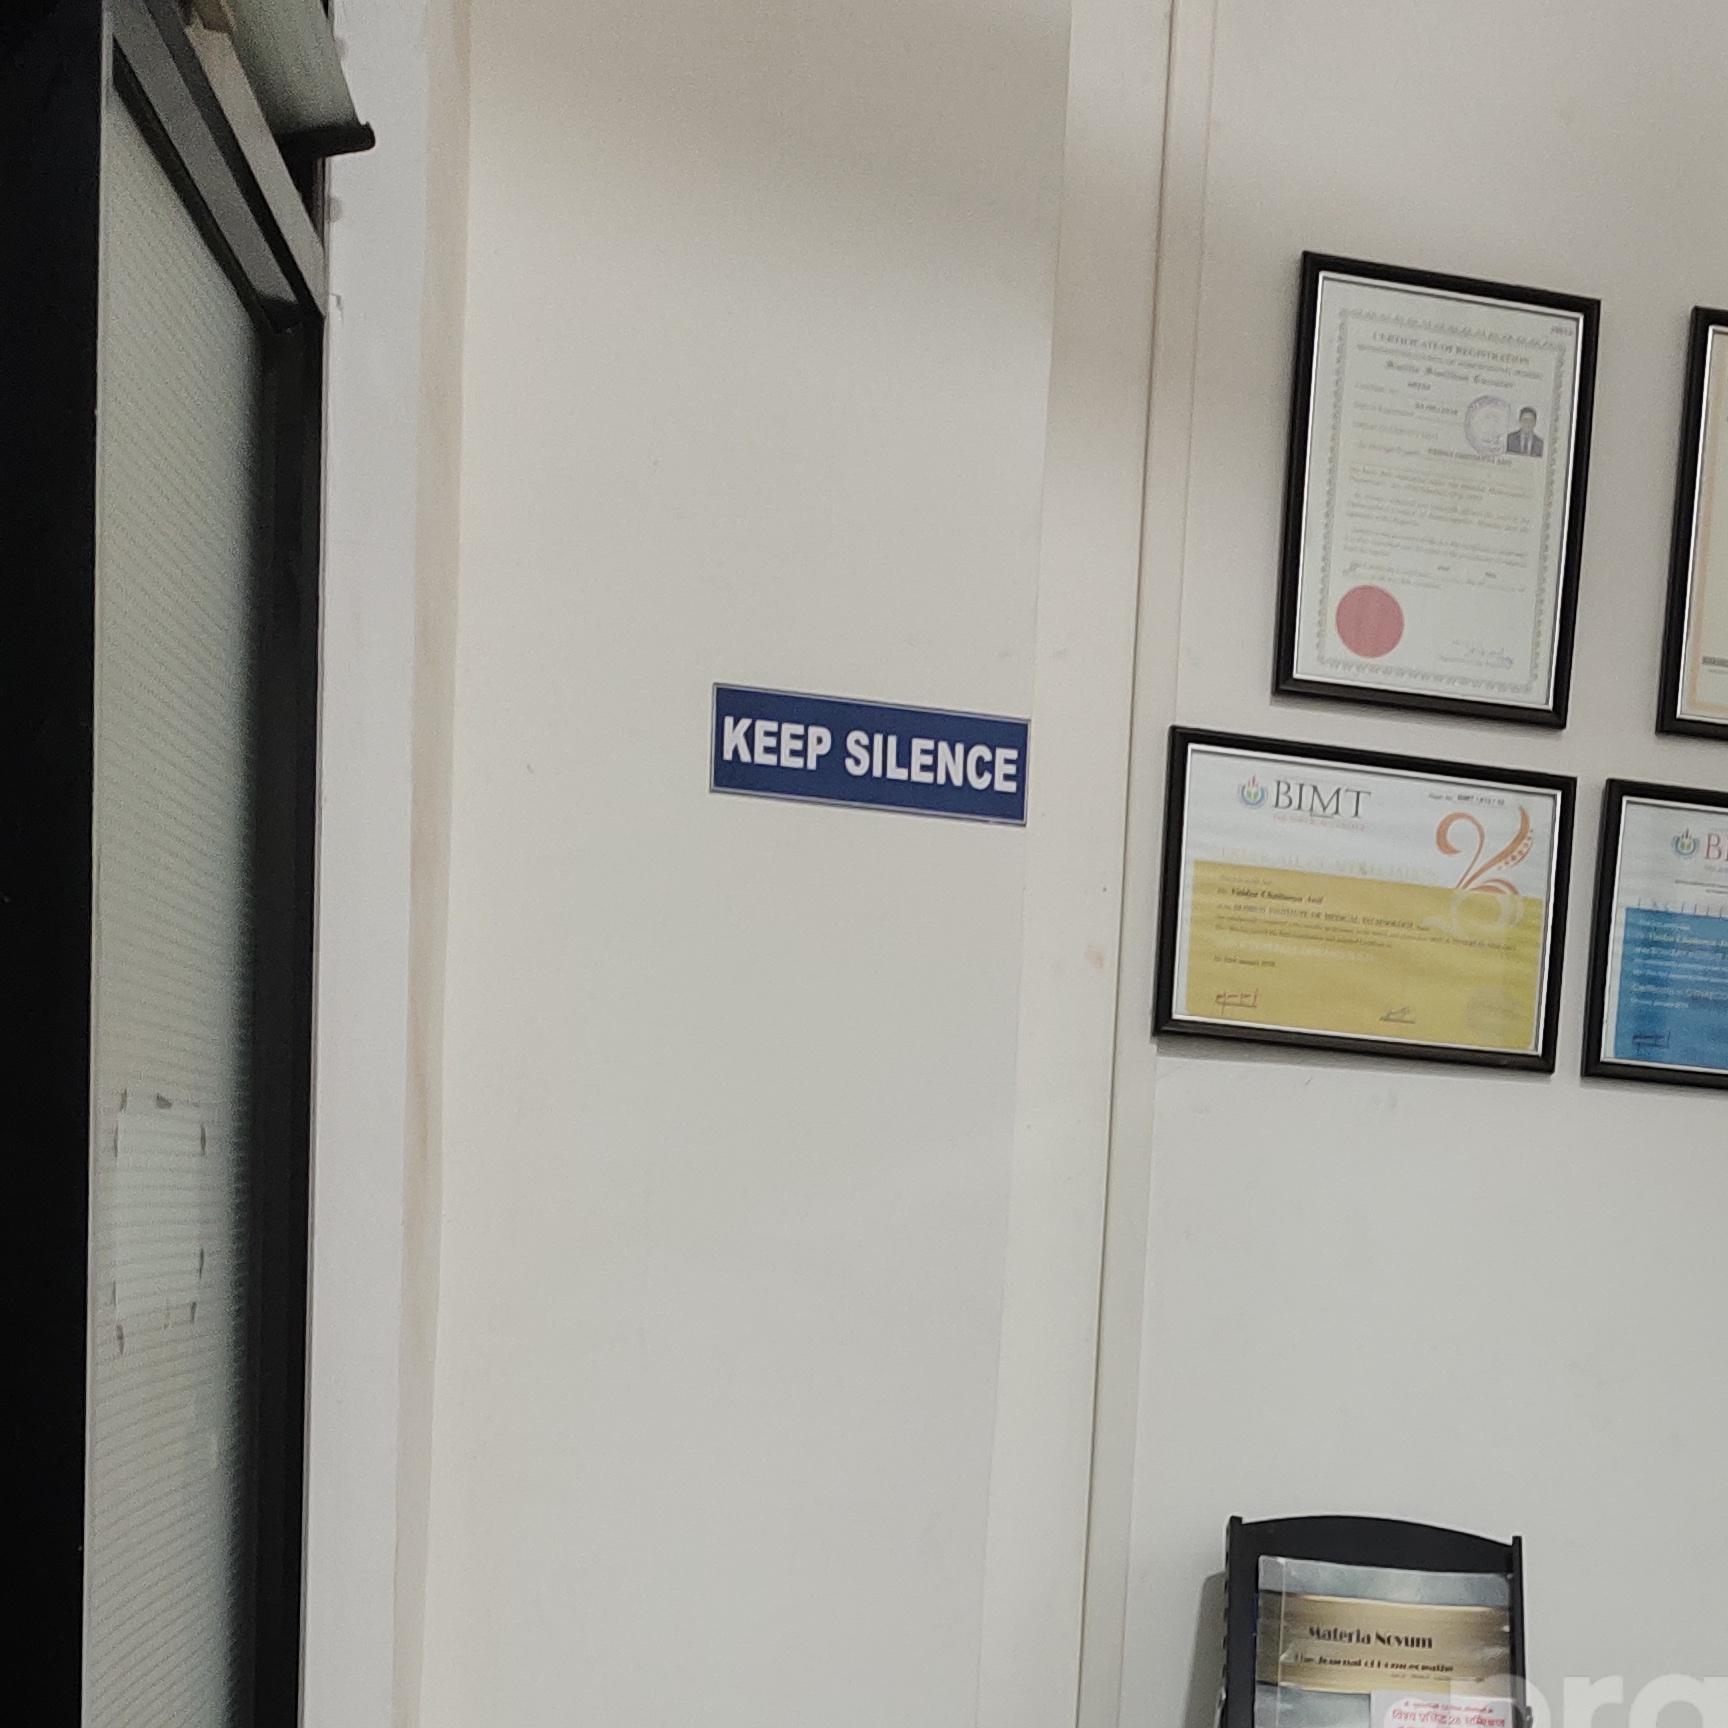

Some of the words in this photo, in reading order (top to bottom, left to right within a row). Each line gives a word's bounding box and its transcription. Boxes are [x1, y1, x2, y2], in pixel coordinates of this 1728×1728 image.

[722, 715, 832, 771] KEEP
[844, 729, 1019, 793] SILENCE
[1272, 778, 1372, 820] BIMT
[1308, 1625, 1371, 1646] Materia
[1374, 1631, 1434, 1650] Novum
